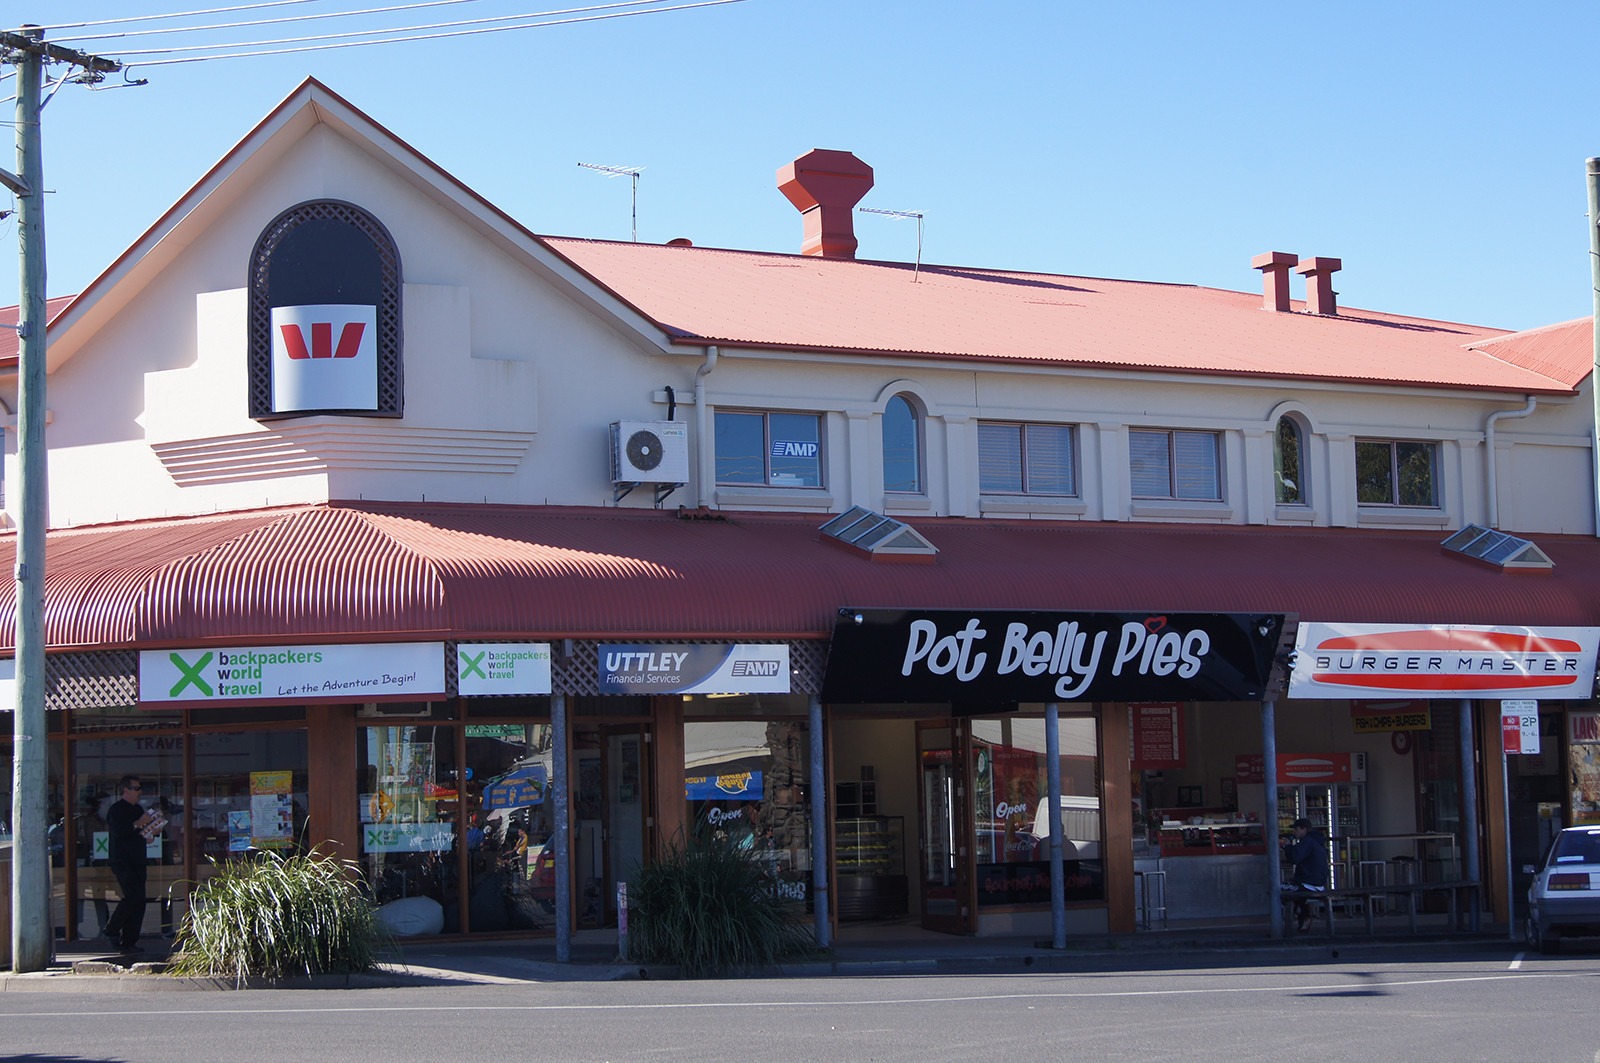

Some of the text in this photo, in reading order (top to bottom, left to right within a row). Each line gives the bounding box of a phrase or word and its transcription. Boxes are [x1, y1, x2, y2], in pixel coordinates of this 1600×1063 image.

[784, 443, 817, 457] AMP
[219, 650, 322, 667] backpackers
[488, 651, 549, 661] backpackers
[606, 652, 688, 672] UTTLEY
[901, 616, 1210, 698] Pot Belly Pies
[488, 660, 514, 669] world
[745, 662, 779, 676] AMP
[1316, 657, 1578, 671] BURGER MASTER
[218, 666, 262, 680] world
[488, 670, 515, 679] travel
[606, 674, 681, 684] Financial Services
[219, 682, 262, 696] travel
[278, 672, 416, 695] Let the Adventure Begin!
[1521, 717, 1537, 727] 2P
[134, 738, 183, 750] TRAVE
[707, 807, 742, 826] Open
[996, 801, 1027, 820] Open
